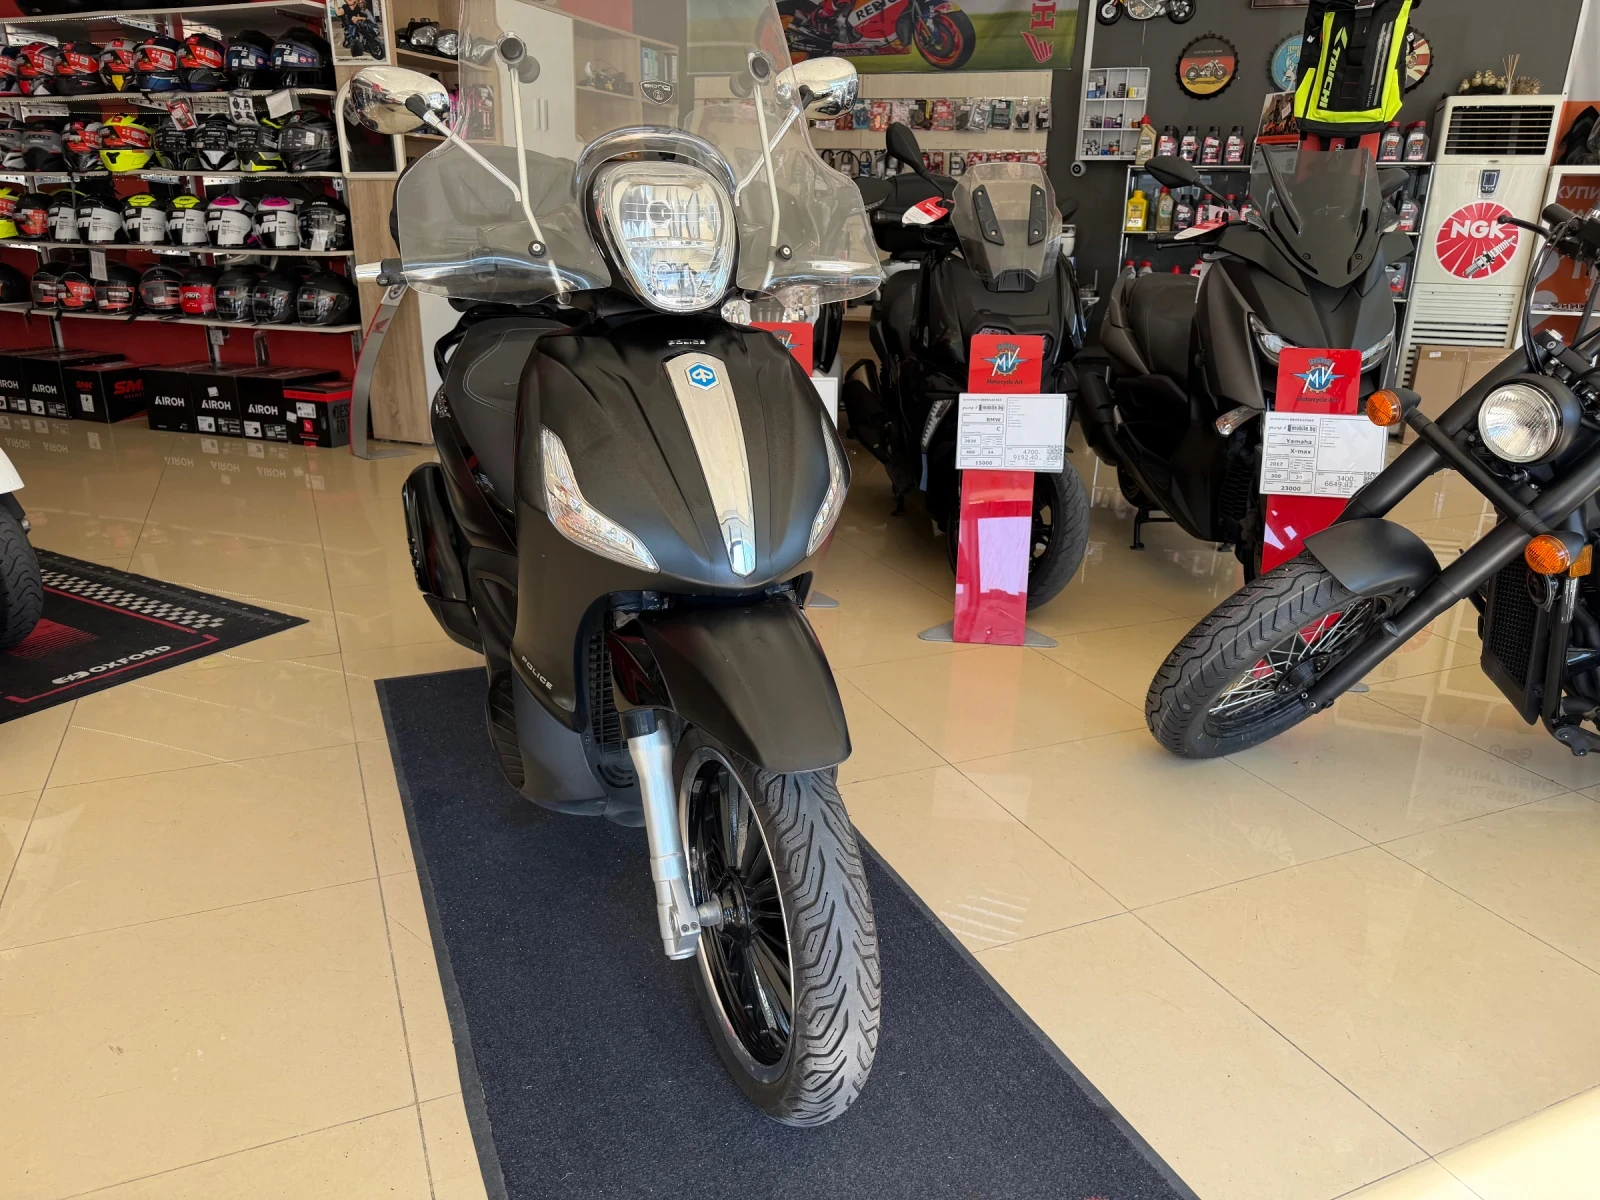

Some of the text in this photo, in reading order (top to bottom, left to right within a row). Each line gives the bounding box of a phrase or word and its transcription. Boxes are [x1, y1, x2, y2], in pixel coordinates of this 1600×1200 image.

[1319, 46, 1340, 108] TAICHI
[1450, 220, 1506, 240] NGK
[32, 384, 57, 394] AIROH
[114, 379, 144, 395] SM
[155, 396, 185, 407] AIROH
[202, 400, 232, 410] AIROH
[248, 404, 278, 415] AIROH
[90, 645, 171, 674] OXFORD
[521, 655, 554, 690] POLICE
